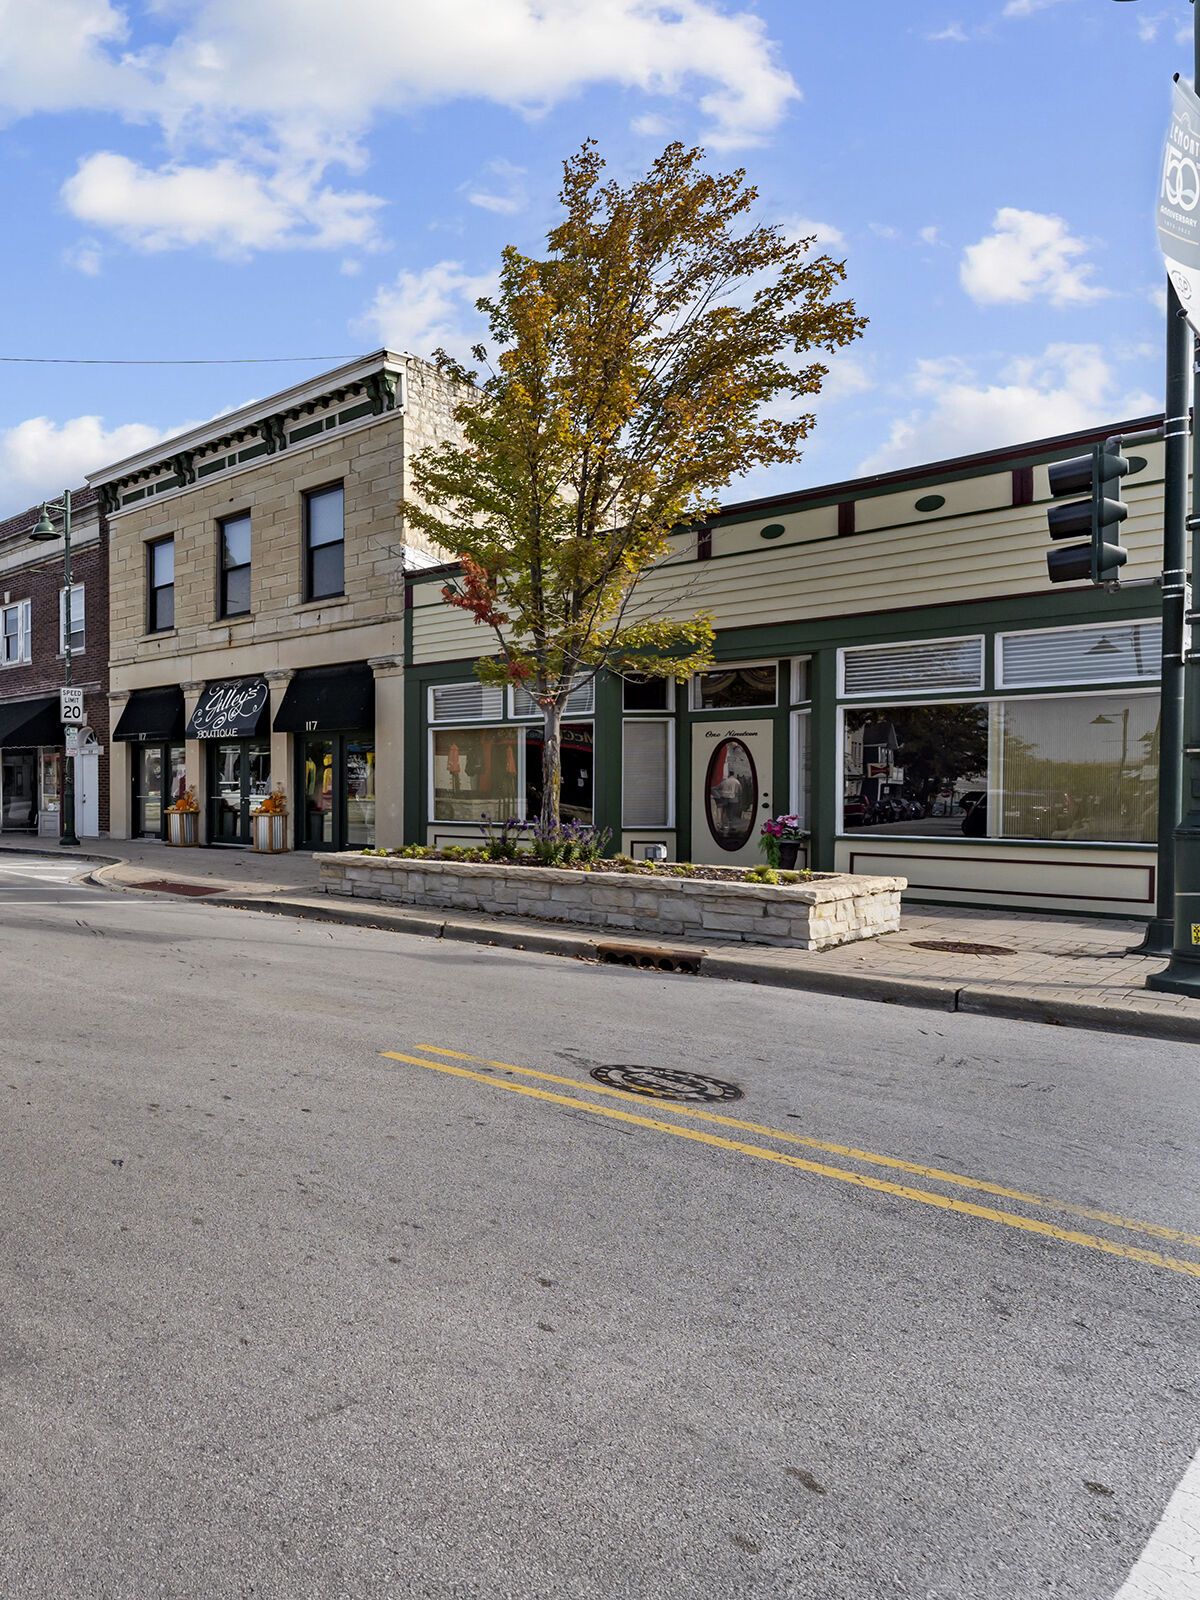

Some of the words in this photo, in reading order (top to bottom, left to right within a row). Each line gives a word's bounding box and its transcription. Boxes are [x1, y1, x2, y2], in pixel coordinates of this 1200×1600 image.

[1170, 122, 1200, 157] LEMONT
[1161, 141, 1200, 211] 150
[63, 705, 81, 719] 20
[305, 720, 318, 731] 117
[196, 727, 239, 739] BOUTIQUE
[705, 730, 721, 738] One
[725, 729, 758, 737] Nineteen
